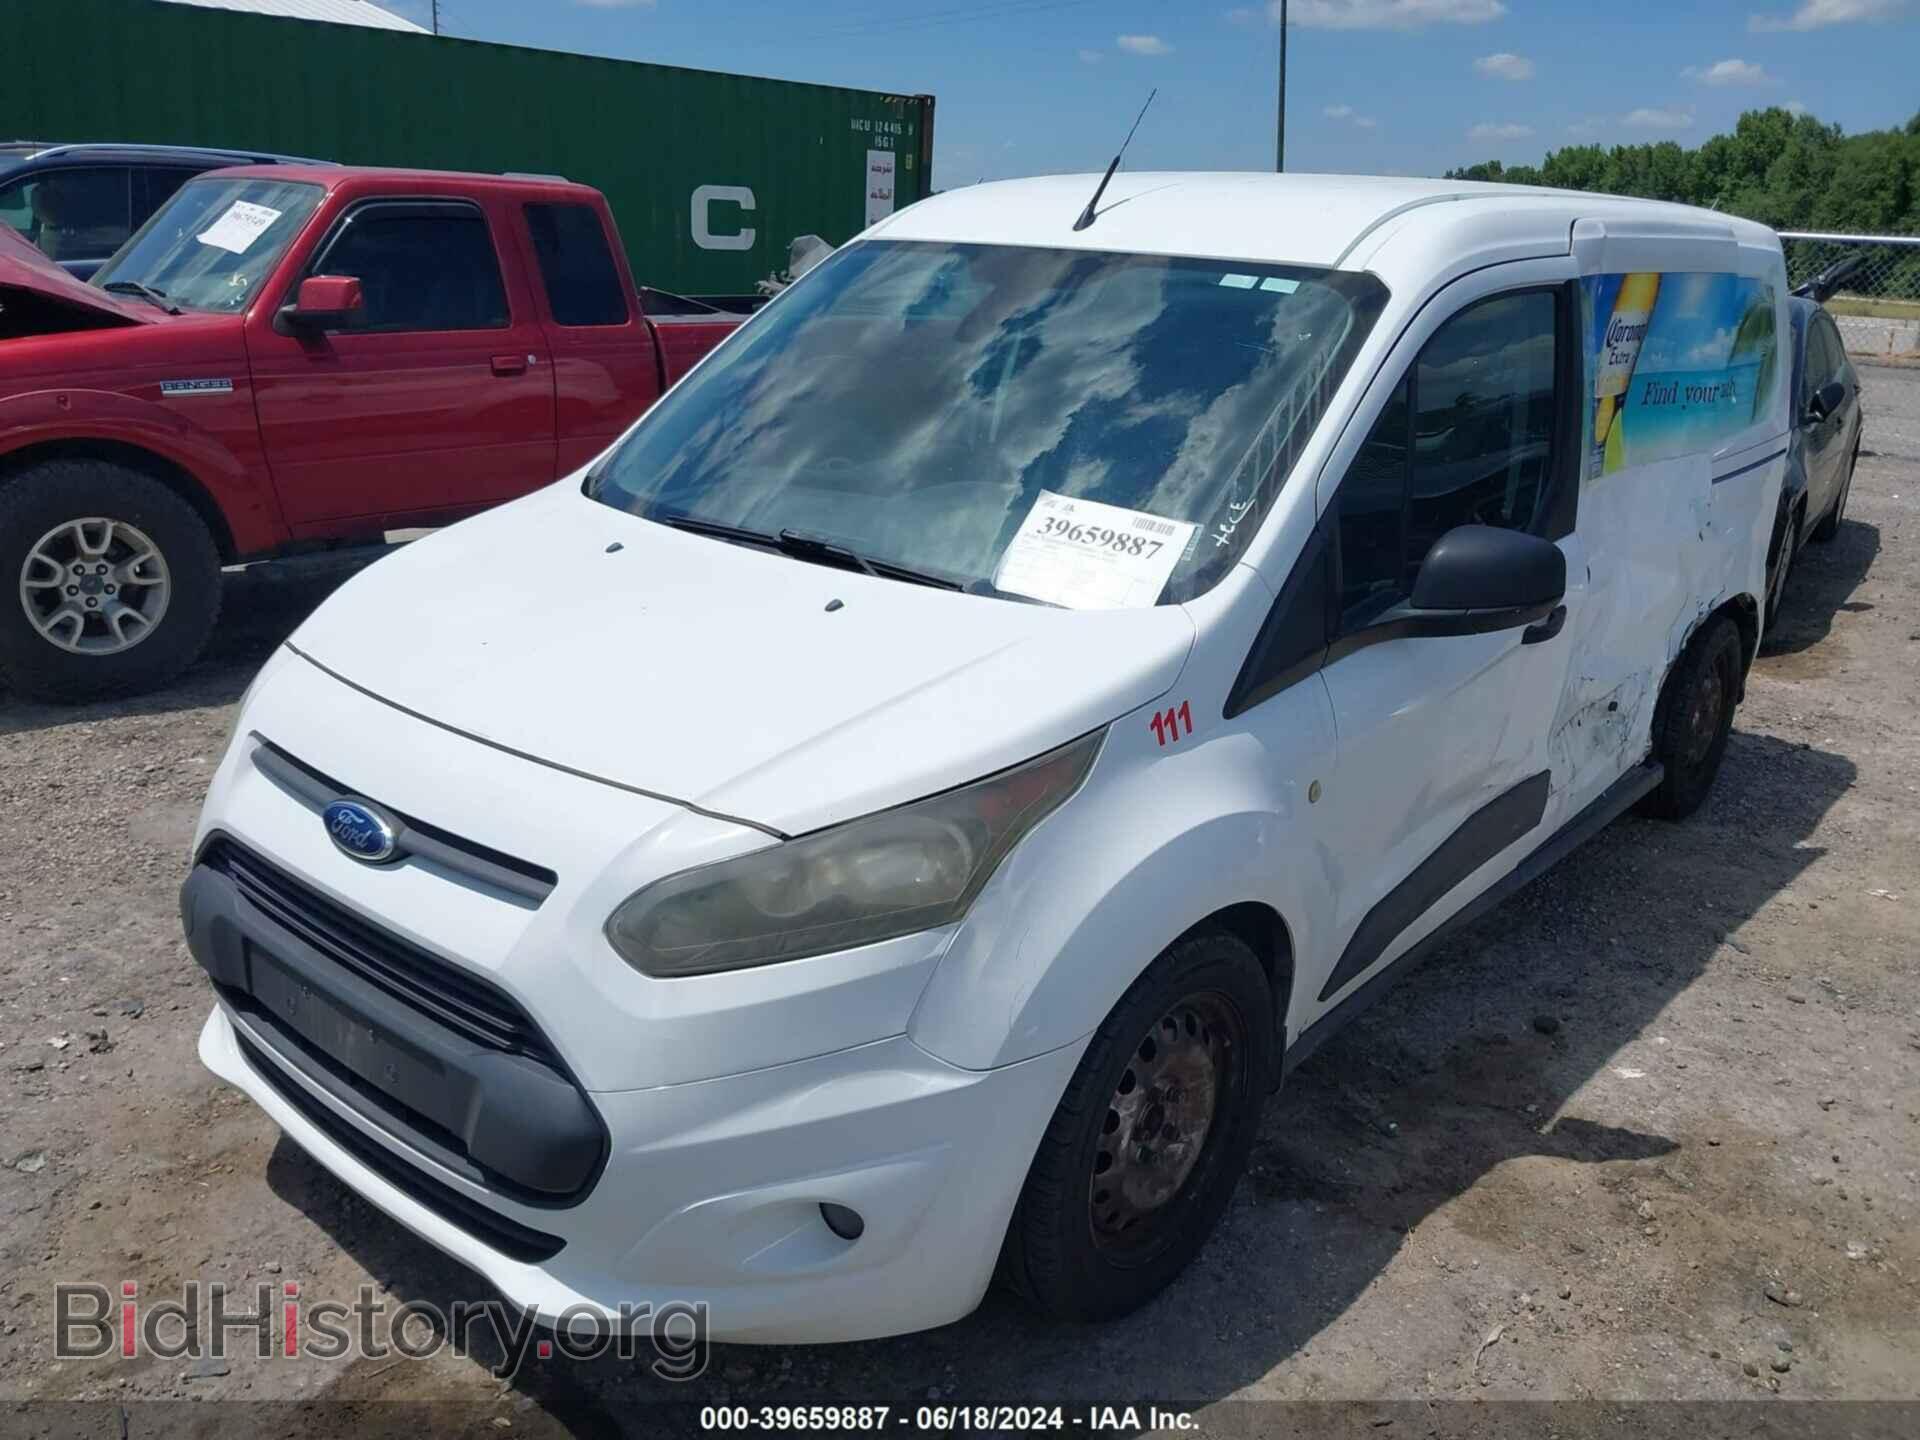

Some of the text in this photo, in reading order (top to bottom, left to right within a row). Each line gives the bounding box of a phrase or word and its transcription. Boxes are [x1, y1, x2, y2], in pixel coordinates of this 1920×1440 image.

[691, 184, 756, 250] C
[162, 380, 231, 391] RANGER
[1641, 381, 1680, 405] Find
[1683, 384, 1720, 411] your
[1036, 516, 1164, 560] 39659887
[1150, 700, 1193, 746] 111
[331, 809, 373, 848] Ford
